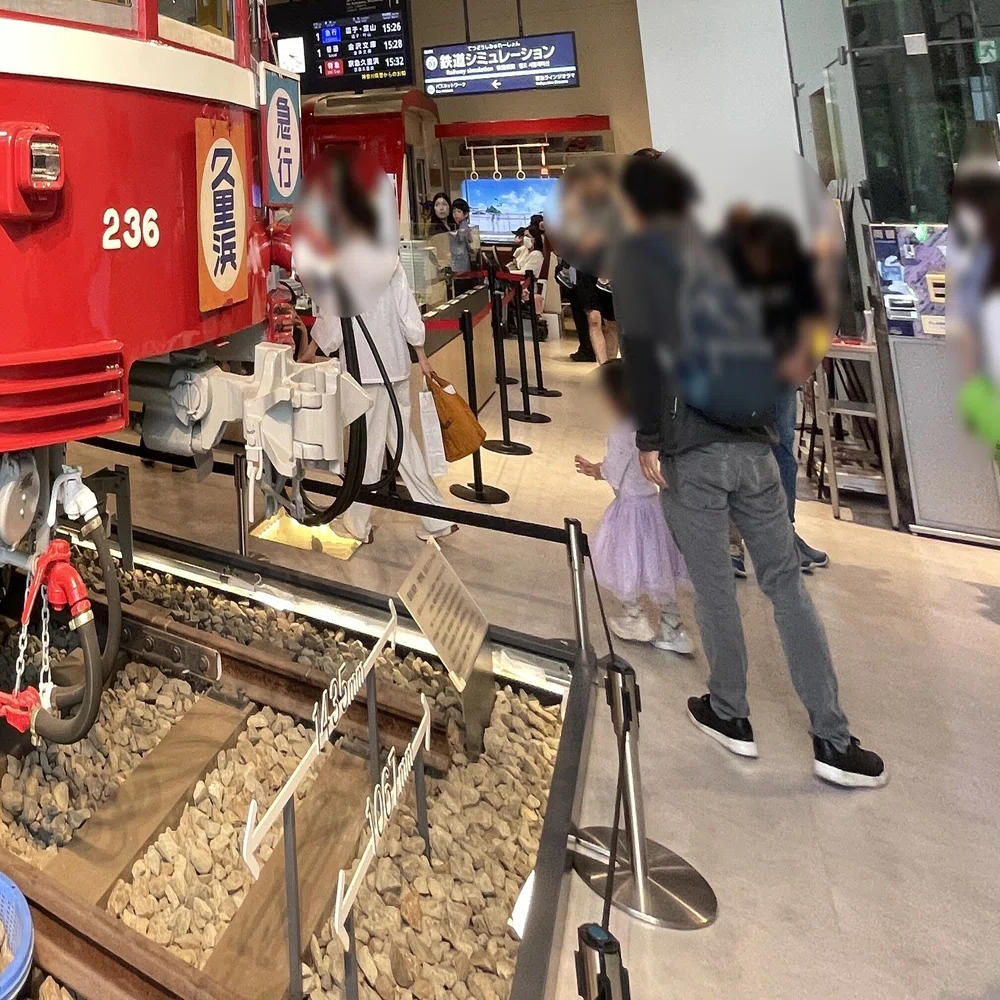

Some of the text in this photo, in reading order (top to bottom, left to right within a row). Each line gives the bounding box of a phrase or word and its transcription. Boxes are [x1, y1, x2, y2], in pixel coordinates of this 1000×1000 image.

[382, 22, 402, 33] 15:26
[384, 40, 402, 50] 15:28
[385, 56, 404, 68] 15:32
[440, 45, 556, 70] 鉄道シミュレーション
[276, 96, 292, 188] 急行
[102, 207, 160, 250] 236
[211, 148, 237, 278] 久里浜
[312, 661, 365, 756] 1435mm
[365, 742, 414, 856] 1067mm
